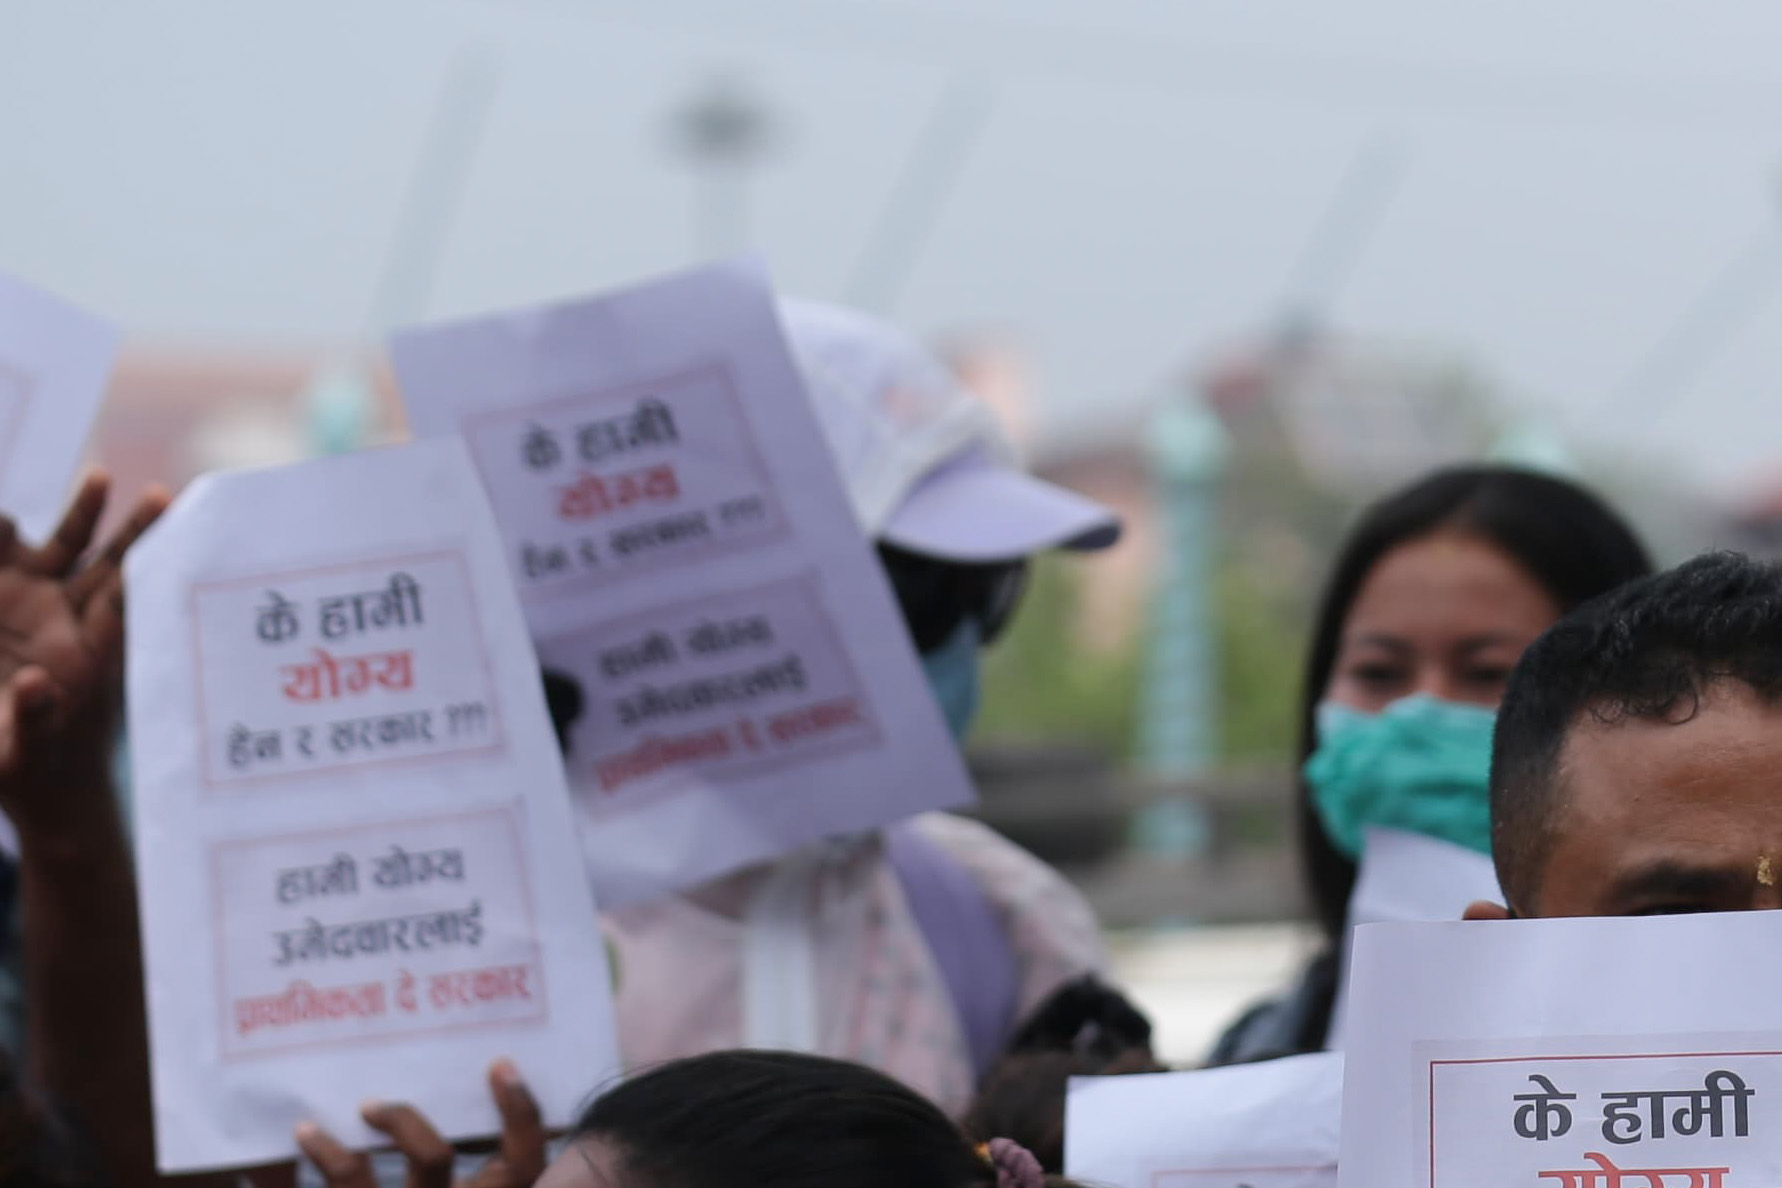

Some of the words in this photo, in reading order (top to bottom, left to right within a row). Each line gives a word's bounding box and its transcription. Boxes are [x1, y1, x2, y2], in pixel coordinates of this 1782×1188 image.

[255, 591, 300, 645] के
[318, 572, 424, 634] हामी
[280, 648, 417, 705] योग्य
[275, 854, 359, 906] हामी
[1514, 1075, 1576, 1141] के
[1601, 1071, 1755, 1144] हामी
